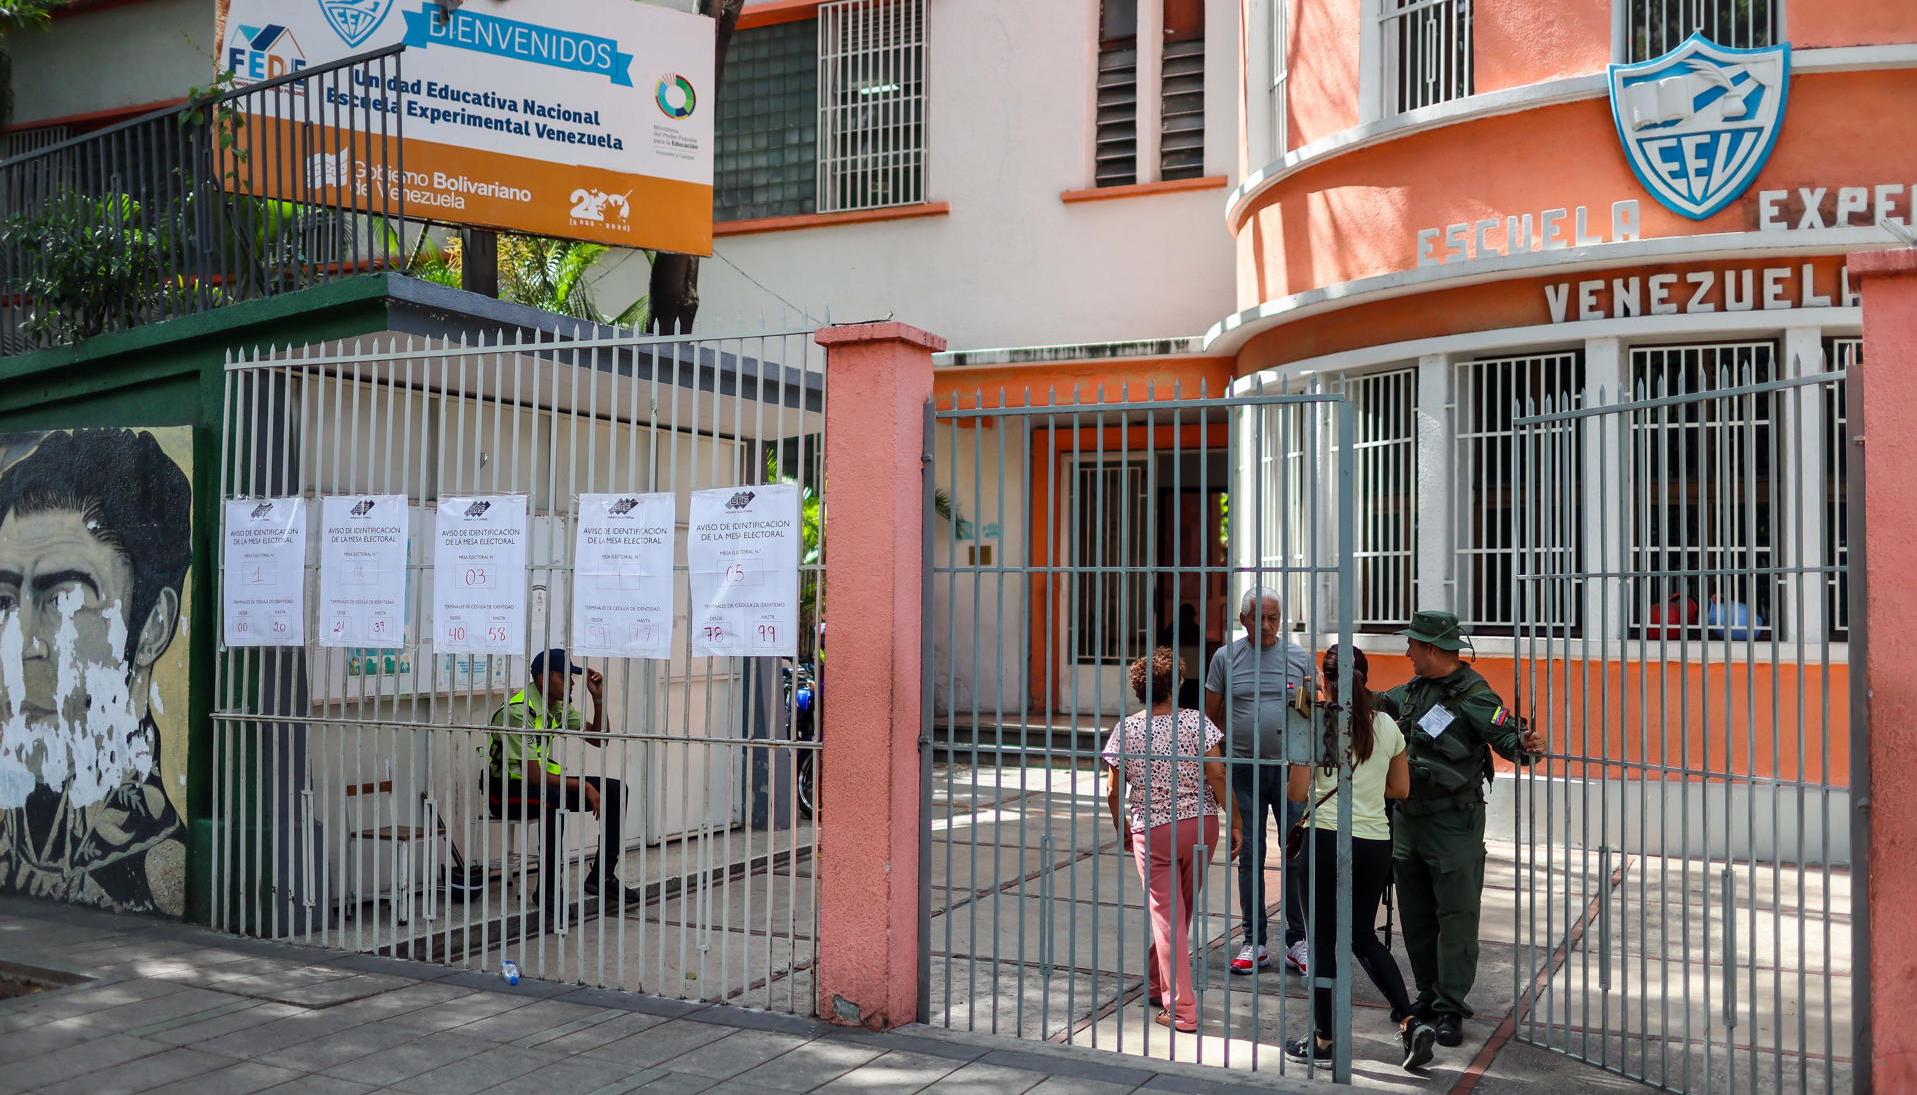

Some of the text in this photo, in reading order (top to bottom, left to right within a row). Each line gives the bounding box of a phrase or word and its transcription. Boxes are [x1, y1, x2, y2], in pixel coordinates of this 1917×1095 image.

[429, 10, 611, 69] BIENVENIDOS
[354, 68, 600, 125] Undad Educativa Nacional
[407, 100, 530, 136] Experimental
[535, 122, 623, 150] Venezuela
[1642, 131, 1757, 199] EEV
[433, 171, 532, 202] Bolivariano
[1417, 183, 1917, 268] ESCUELA EXPE
[441, 529, 458, 537] AVISO
[459, 529, 467, 537] DE
[696, 523, 718, 532] AVISO
[701, 533, 712, 541] DE
[713, 533, 723, 541] LA
[743, 530, 785, 539] ELECTORAL
[465, 568, 486, 586] 03
[449, 626, 465, 641] 40
[488, 626, 506, 642] 58
[704, 626, 724, 643] 78
[758, 624, 776, 643] 99
